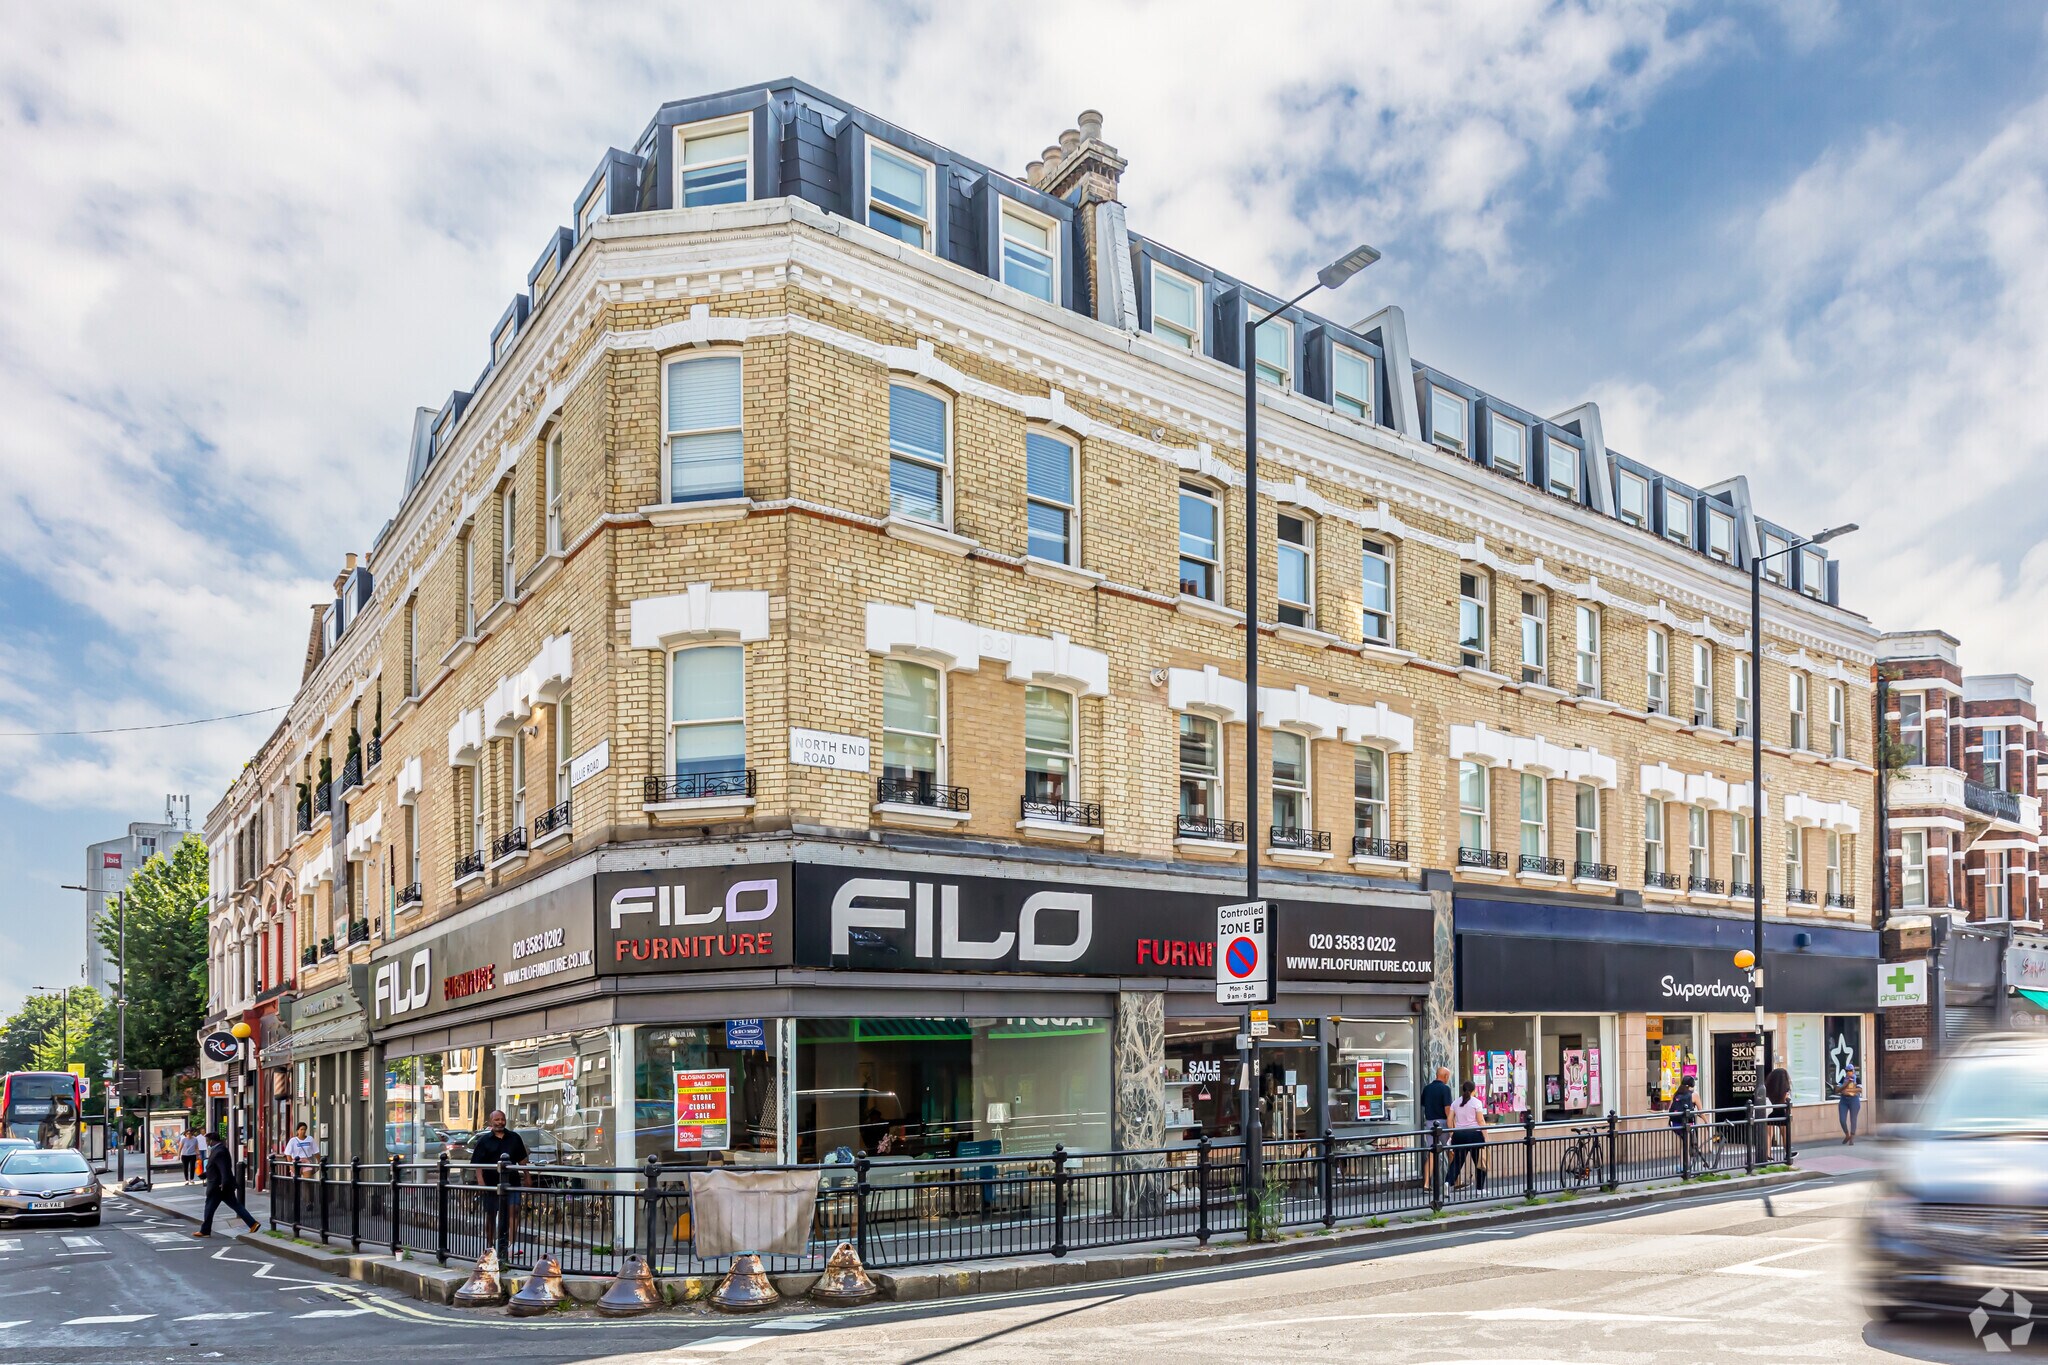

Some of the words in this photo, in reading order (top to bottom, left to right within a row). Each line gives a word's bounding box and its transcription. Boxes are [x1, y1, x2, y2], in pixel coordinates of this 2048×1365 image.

[796, 738, 836, 752] NORTH
[842, 744, 865, 756] END
[804, 752, 835, 765] ROAD
[573, 767, 586, 783] LILLIE
[587, 759, 599, 774] ROAD
[611, 879, 778, 929] FILO
[1220, 906, 1264, 919] Controlled
[831, 878, 1092, 962] FILO
[1220, 922, 1250, 935] ZONE
[513, 942, 525, 960] 020
[526, 934, 544, 956] 3583
[544, 928, 564, 952] 0202
[616, 932, 772, 962] FURNITURE
[1309, 934, 1333, 950] 020
[1335, 935, 1365, 951] 3583
[1366, 936, 1396, 952] 0202
[1137, 939, 1216, 966] FURNI
[503, 950, 592, 986] WWW.FILOFURNITURE.CO.UK
[1286, 957, 1432, 973] WWW.FILOFURNITURE.CO.UK
[376, 948, 431, 1020] FILO
[444, 964, 495, 1001] FURNITURE
[1661, 975, 1751, 1004] Superdrug
[1880, 993, 1920, 1004] pharmacy
[1732, 1048, 1756, 1057] SKIN
[1189, 1061, 1220, 1073] SALE
[1496, 1064, 1504, 1075] £5
[1207, 1073, 1220, 1081] ON!
